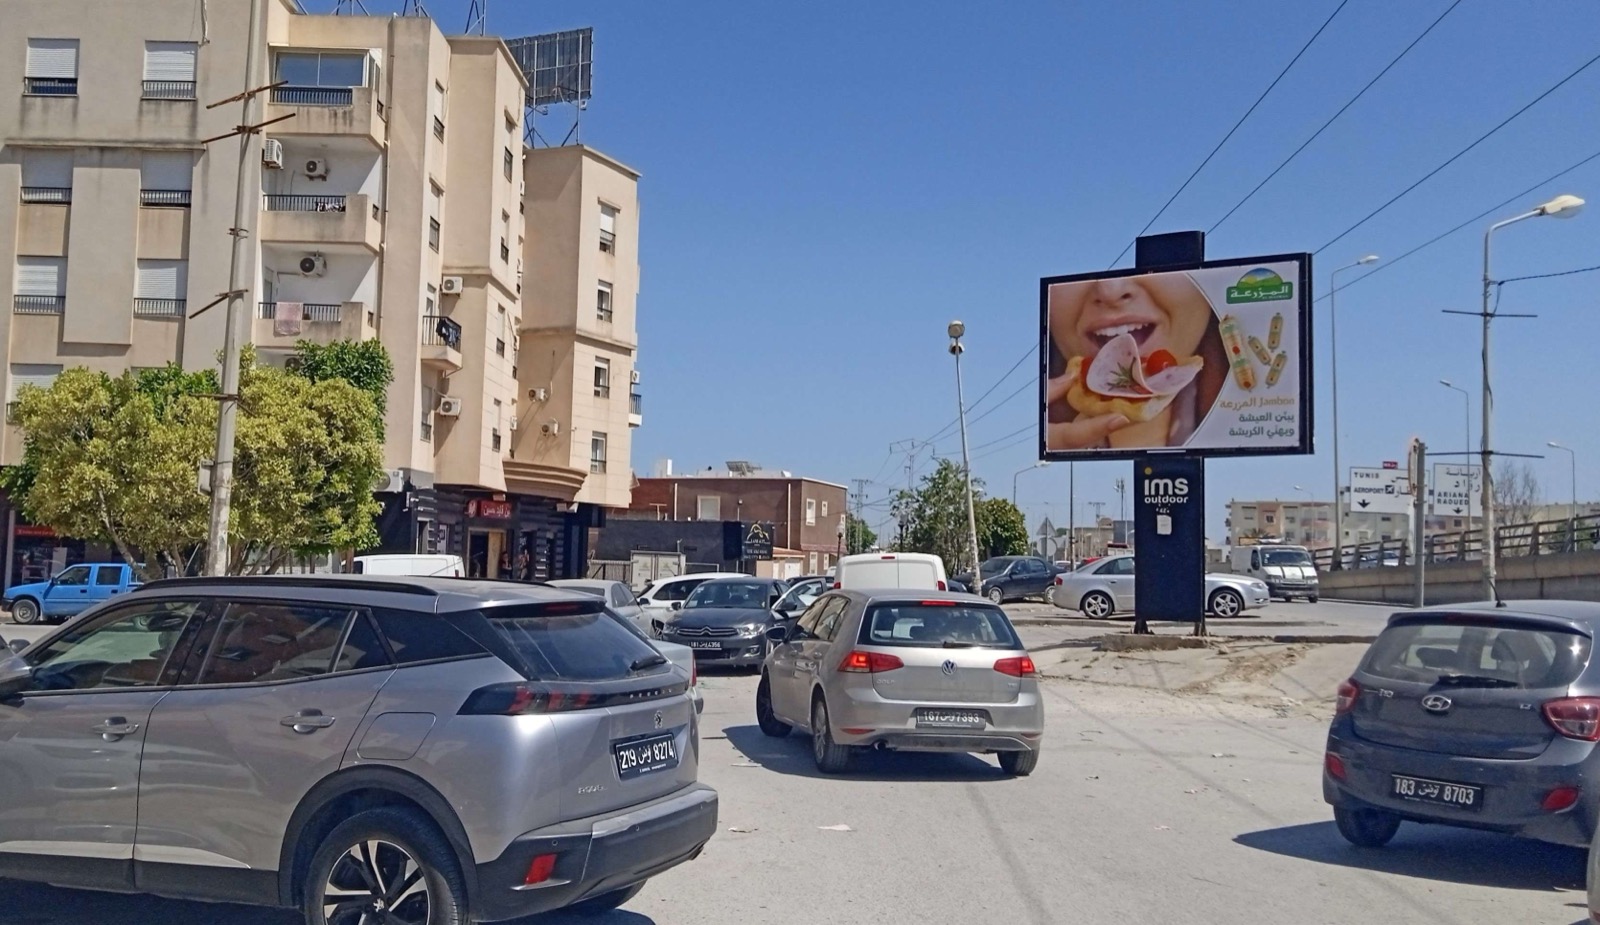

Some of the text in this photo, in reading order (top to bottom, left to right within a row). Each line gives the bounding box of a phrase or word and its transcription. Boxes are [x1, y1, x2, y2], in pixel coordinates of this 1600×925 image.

[1231, 285, 1289, 299] المزرعة
[1258, 395, 1295, 407] Jambon
[1239, 411, 1272, 424] العيشة
[1229, 426, 1264, 438] الكريشة
[1353, 471, 1379, 479] TUNIS
[1353, 486, 1384, 495] AEROPORT
[1144, 495, 1188, 504] outdoor
[1437, 498, 1469, 506] RAOUED
[923, 711, 940, 722] 167
[955, 711, 980, 723] 7393
[620, 748, 637, 769] 219
[653, 740, 675, 760] 8274
[1395, 778, 1415, 796] 183
[1443, 785, 1474, 804] 8703
